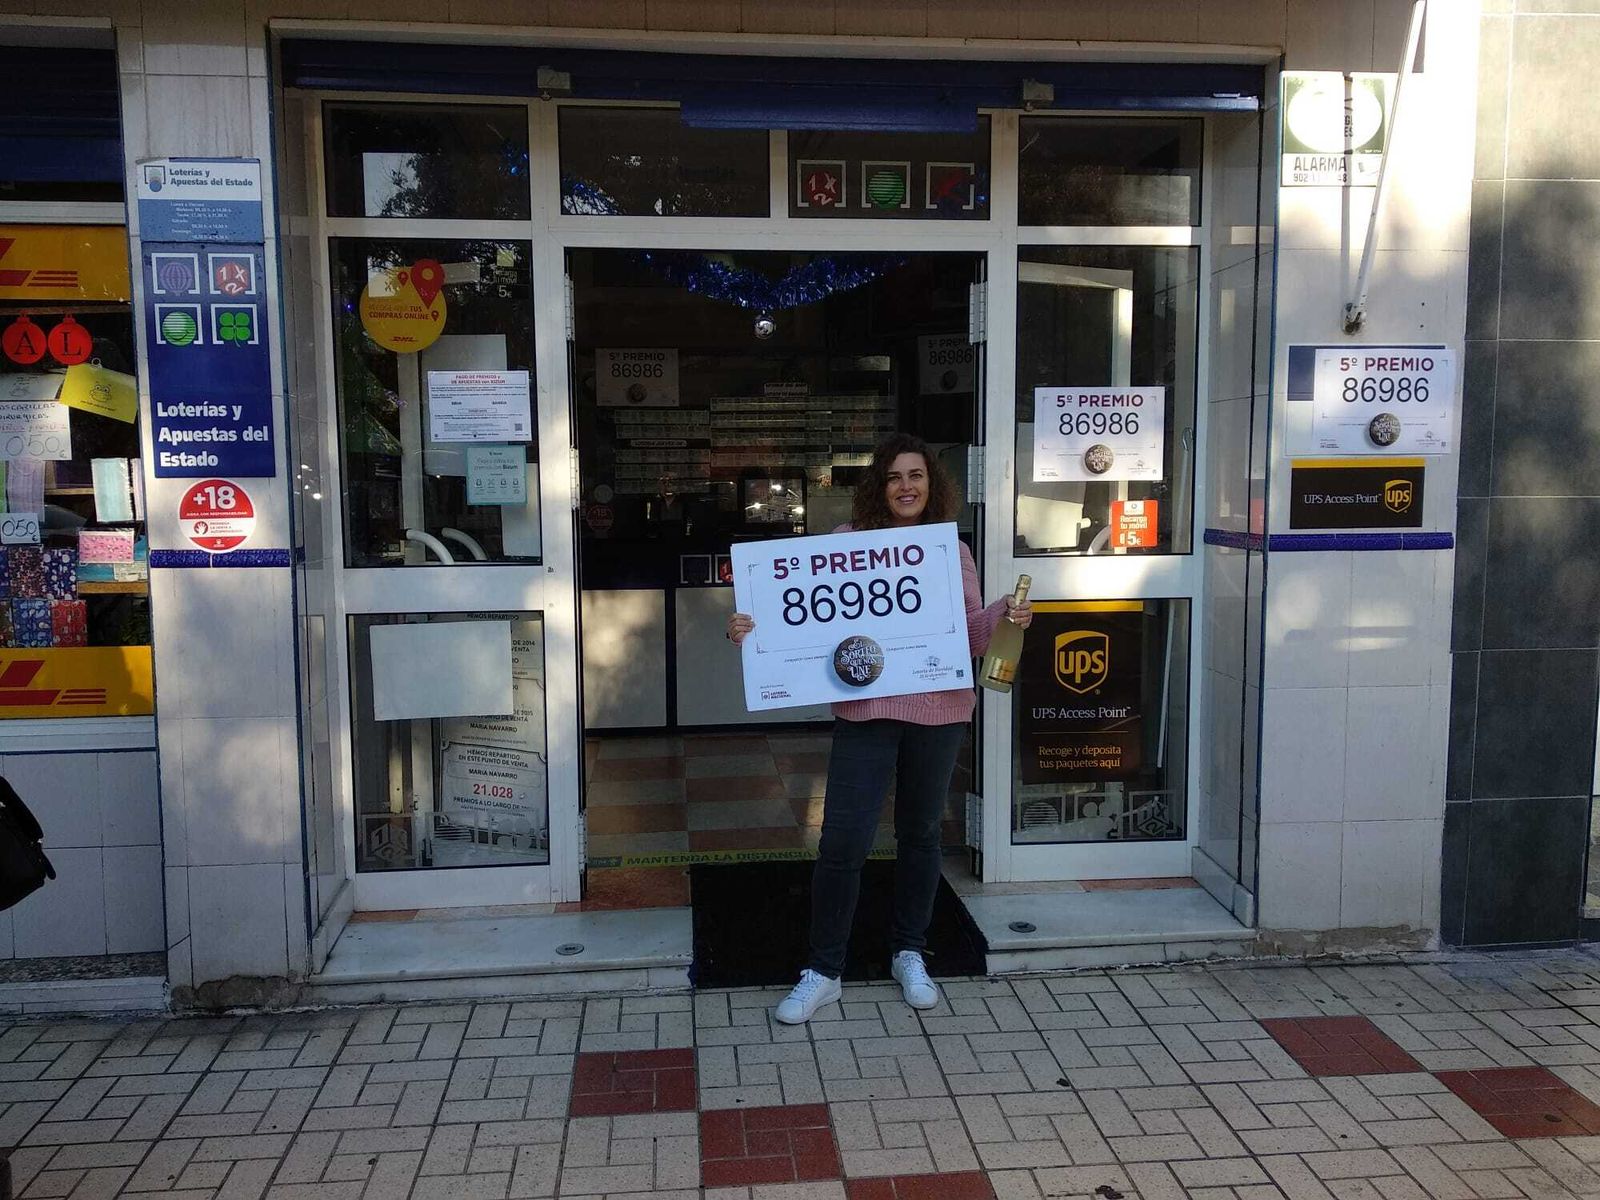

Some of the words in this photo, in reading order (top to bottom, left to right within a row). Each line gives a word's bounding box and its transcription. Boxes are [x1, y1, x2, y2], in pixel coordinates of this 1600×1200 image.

[1294, 156, 1347, 172] ALARMA
[170, 178, 208, 186] Apuestas
[14, 331, 38, 355] A
[61, 332, 82, 355] L
[623, 352, 665, 360] PREMIO
[929, 348, 972, 365] 86986
[1340, 358, 1357, 371] 5º
[1365, 357, 1434, 371] PREMIO
[612, 363, 663, 377] 86986
[1342, 377, 1430, 402] 86986
[1056, 395, 1072, 407] 5º
[1078, 394, 1144, 407] PREMIO
[157, 402, 227, 417] Loterías
[232, 406, 242, 421] y
[1059, 412, 1140, 435] 86986
[158, 427, 238, 446] Apuestas
[242, 426, 269, 441] del
[160, 451, 218, 467] Estado
[193, 486, 236, 510] +18
[1303, 495, 1322, 504] UPS
[1324, 494, 1354, 504] Access
[1387, 489, 1410, 507] ups
[773, 557, 800, 580] 5º
[810, 544, 924, 576] PREMIO
[782, 575, 922, 626] 86986
[840, 646, 876, 664] SORTEO
[863, 657, 876, 665] NOS
[848, 665, 871, 681] UNE
[1059, 650, 1104, 683] ups
[1032, 708, 1056, 719] UPS
[1058, 708, 1096, 719] Access
[489, 751, 520, 760] REPARTIDO
[1039, 746, 1072, 757] Recoge
[1074, 748, 1080, 756] y
[1082, 746, 1122, 757] deposita
[1039, 760, 1054, 768] tus
[1056, 760, 1098, 770] paquetes
[1100, 759, 1121, 769] aquí
[489, 770, 517, 779] NAVARRO
[473, 784, 513, 799] 21.028
[627, 855, 710, 865] MANTENGA
[714, 854, 732, 862] LA
[736, 850, 812, 862] DISTANCIA
